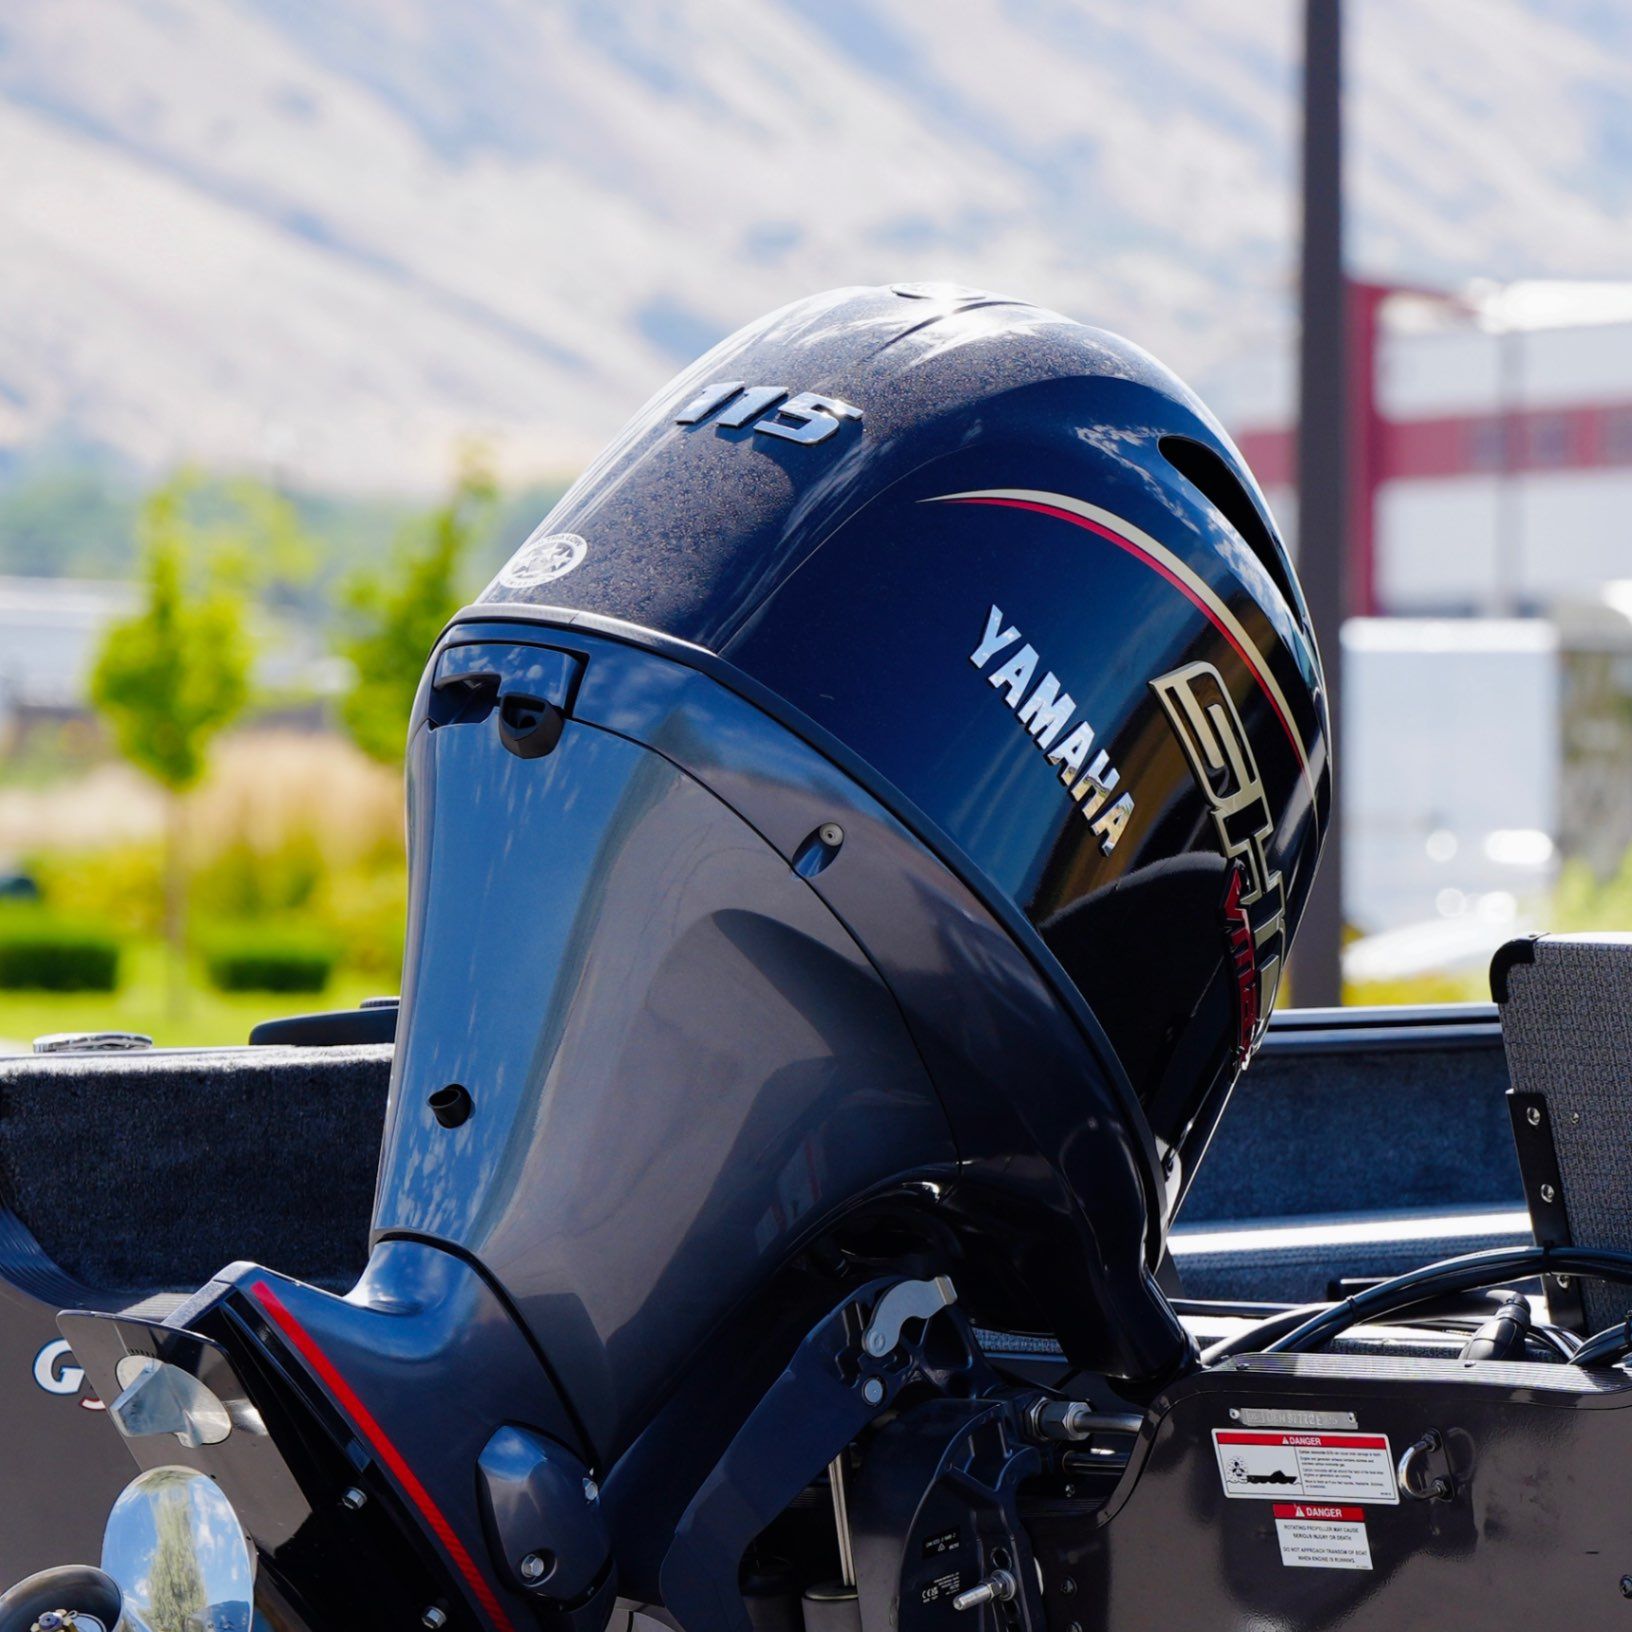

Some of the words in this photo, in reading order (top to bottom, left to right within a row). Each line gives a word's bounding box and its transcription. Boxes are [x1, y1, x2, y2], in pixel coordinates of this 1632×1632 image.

[674, 380, 864, 445] 115
[969, 603, 1135, 857] YAMAHA
[1289, 1434, 1322, 1446] DANGER
[1305, 1507, 1343, 1518] DANGER
